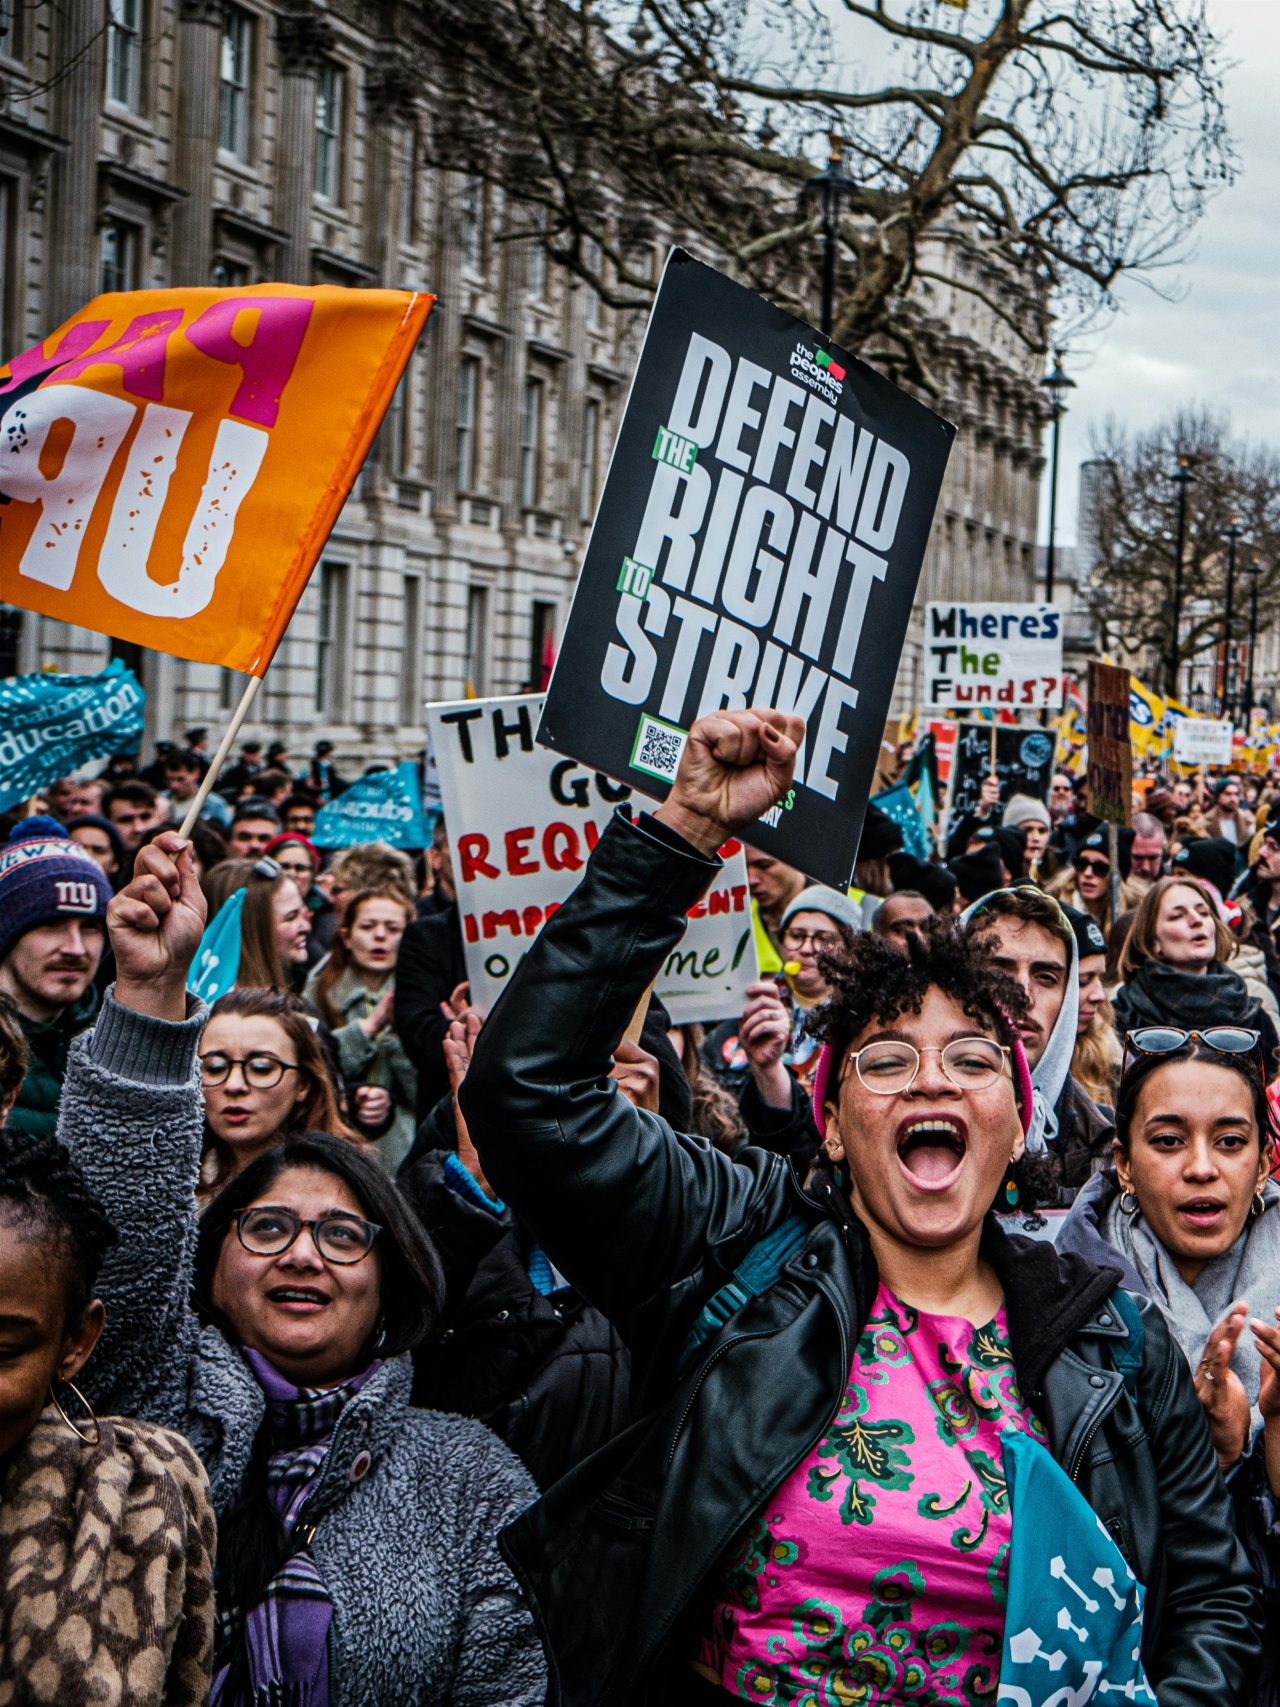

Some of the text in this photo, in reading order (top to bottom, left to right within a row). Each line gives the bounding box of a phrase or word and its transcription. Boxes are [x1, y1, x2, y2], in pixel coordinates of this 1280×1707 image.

[796, 342, 814, 360] the
[789, 351, 843, 394] peoples
[791, 367, 838, 406] assembly
[659, 428, 697, 473] THE
[667, 332, 911, 552] DEFEND
[623, 560, 651, 599] TO
[633, 460, 888, 679] RIGHT
[931, 607, 1060, 640] Where's
[930, 645, 1001, 676] The
[601, 581, 860, 801] STRIKE
[931, 677, 1057, 705] Funds?
